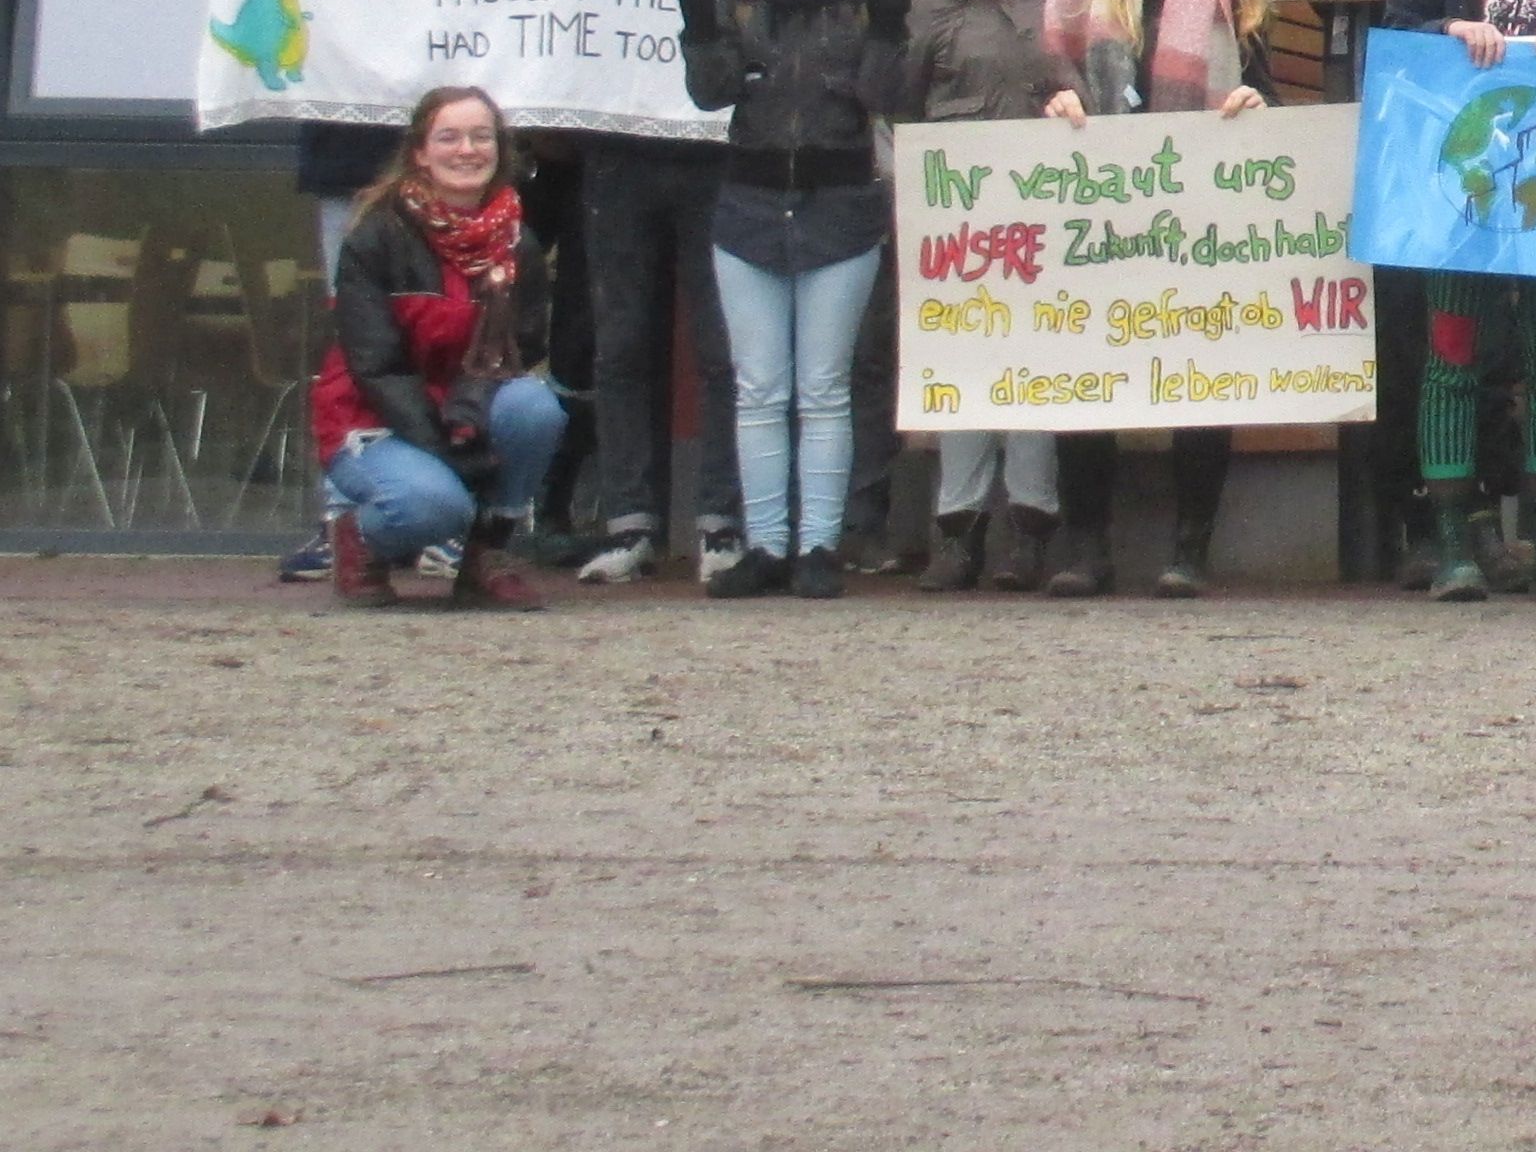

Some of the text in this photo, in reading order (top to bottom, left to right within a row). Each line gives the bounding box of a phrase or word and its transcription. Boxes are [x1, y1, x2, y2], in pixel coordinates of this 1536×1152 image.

[427, 12, 677, 63] HAD TIME TOO
[924, 135, 1296, 209] Ihr verbaut uns
[919, 221, 1047, 284] UNSERE
[1192, 223, 1272, 267] doch
[918, 284, 1012, 337] euch
[1033, 290, 1092, 334] nie
[1240, 291, 1284, 329] ob
[1290, 276, 1369, 332] WIR
[922, 368, 961, 413] in
[990, 367, 1129, 405] dieser
[1150, 356, 1260, 405] leben
